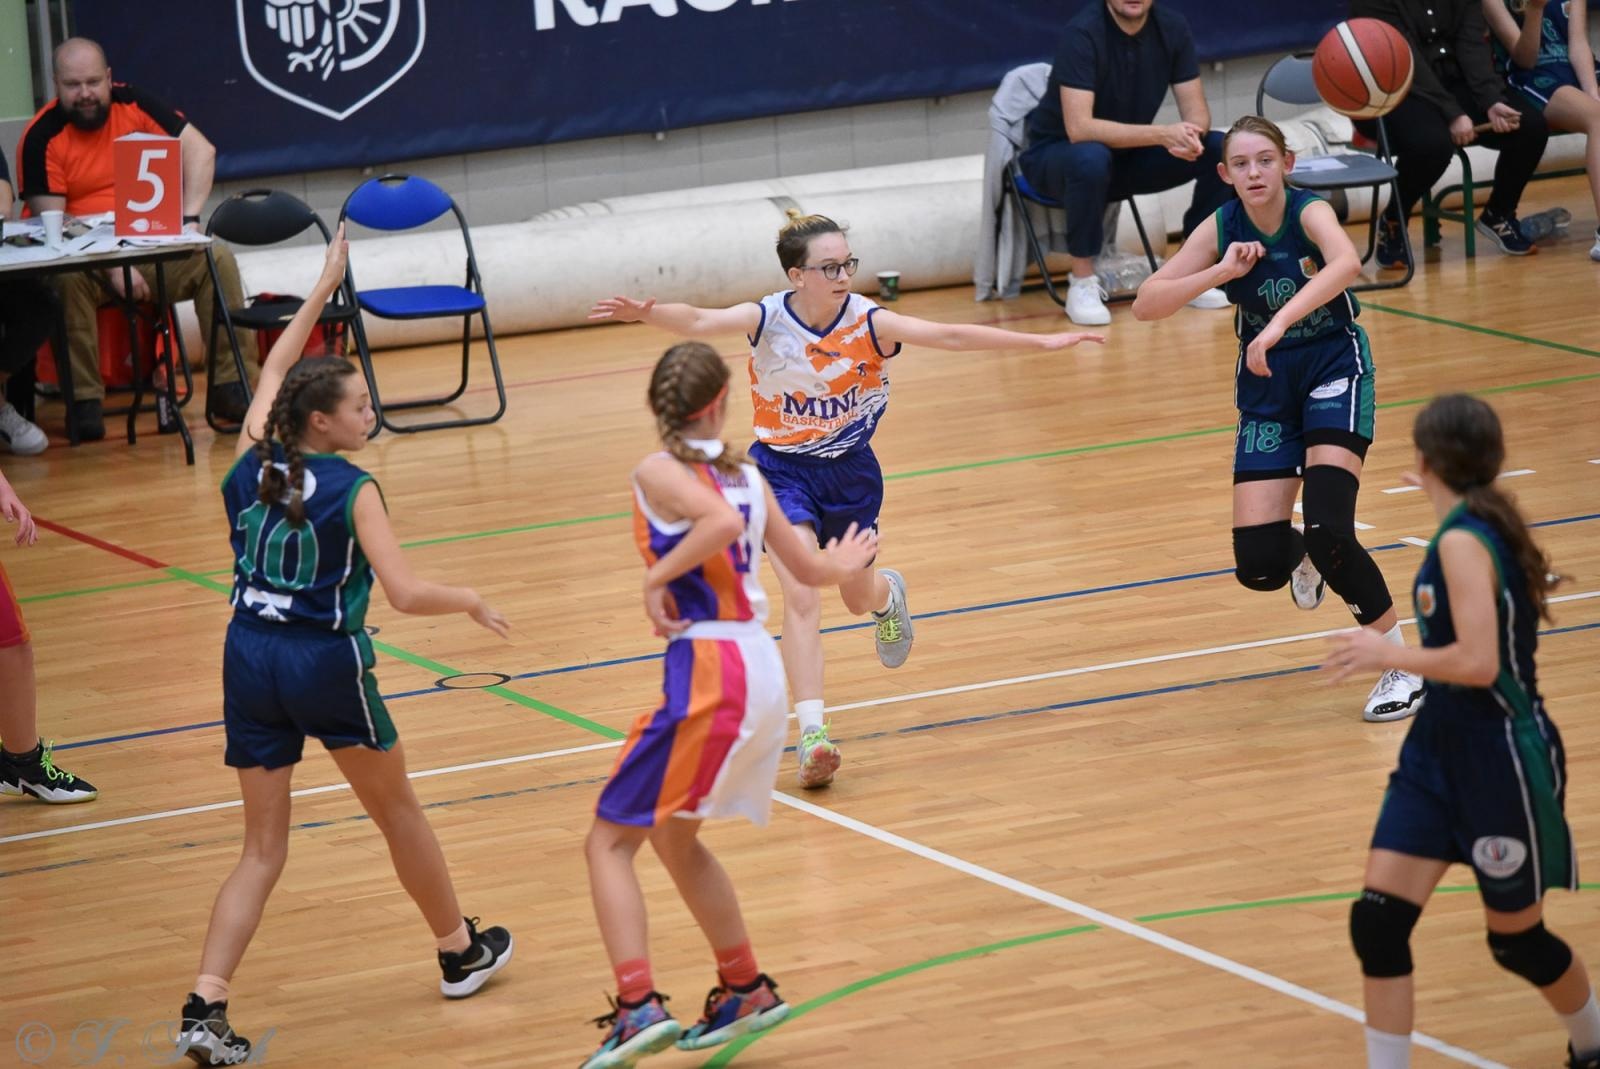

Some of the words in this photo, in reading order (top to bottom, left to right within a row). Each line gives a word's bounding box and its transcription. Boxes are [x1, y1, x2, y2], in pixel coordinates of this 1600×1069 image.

[127, 149, 168, 213] 5
[1257, 277, 1297, 311] 18
[783, 385, 860, 420] MINI
[783, 409, 859, 429] BASKETBALL
[1241, 421, 1282, 454] 18
[236, 500, 319, 591] 10
